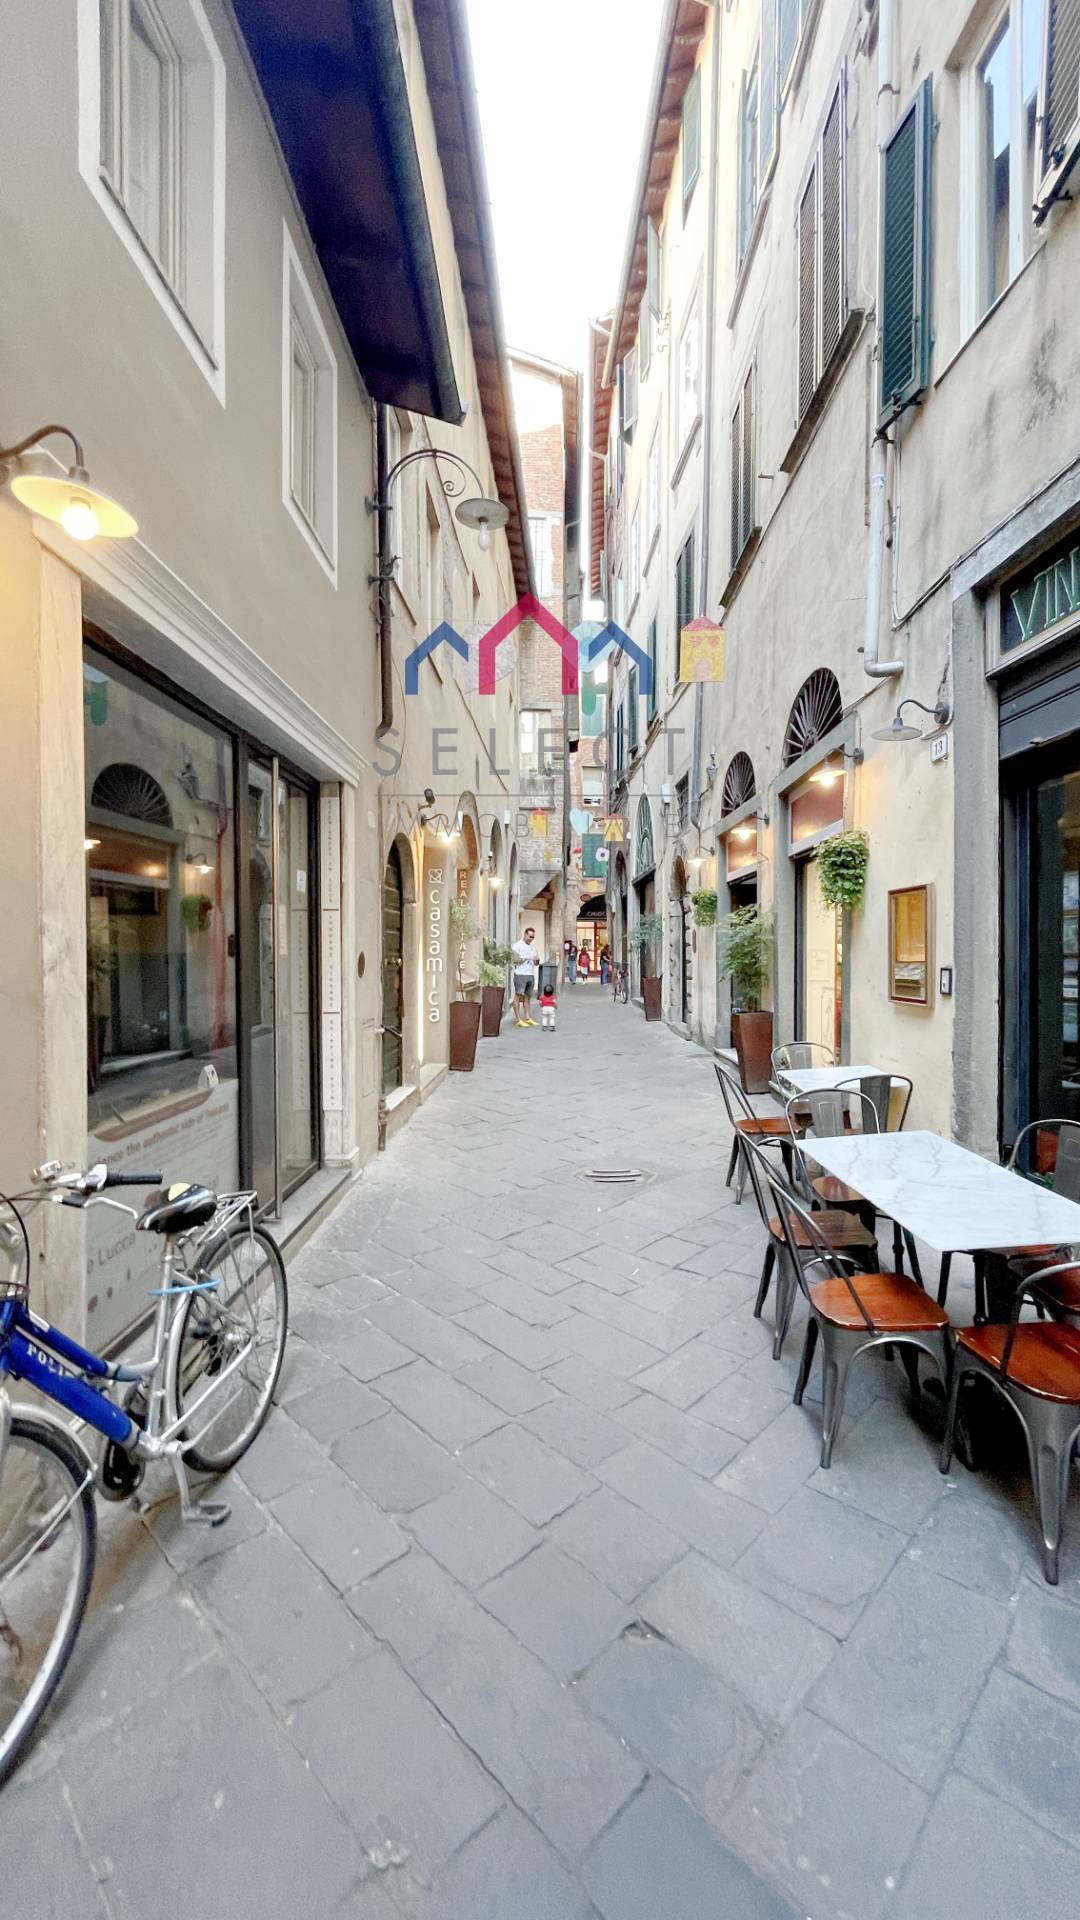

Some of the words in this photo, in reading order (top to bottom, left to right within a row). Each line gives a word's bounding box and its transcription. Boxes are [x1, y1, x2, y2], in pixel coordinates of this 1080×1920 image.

[933, 740, 944, 755] 13
[426, 889, 443, 1022] casamica
[126, 1141, 141, 1156] the
[97, 1231, 137, 1266] Lucca
